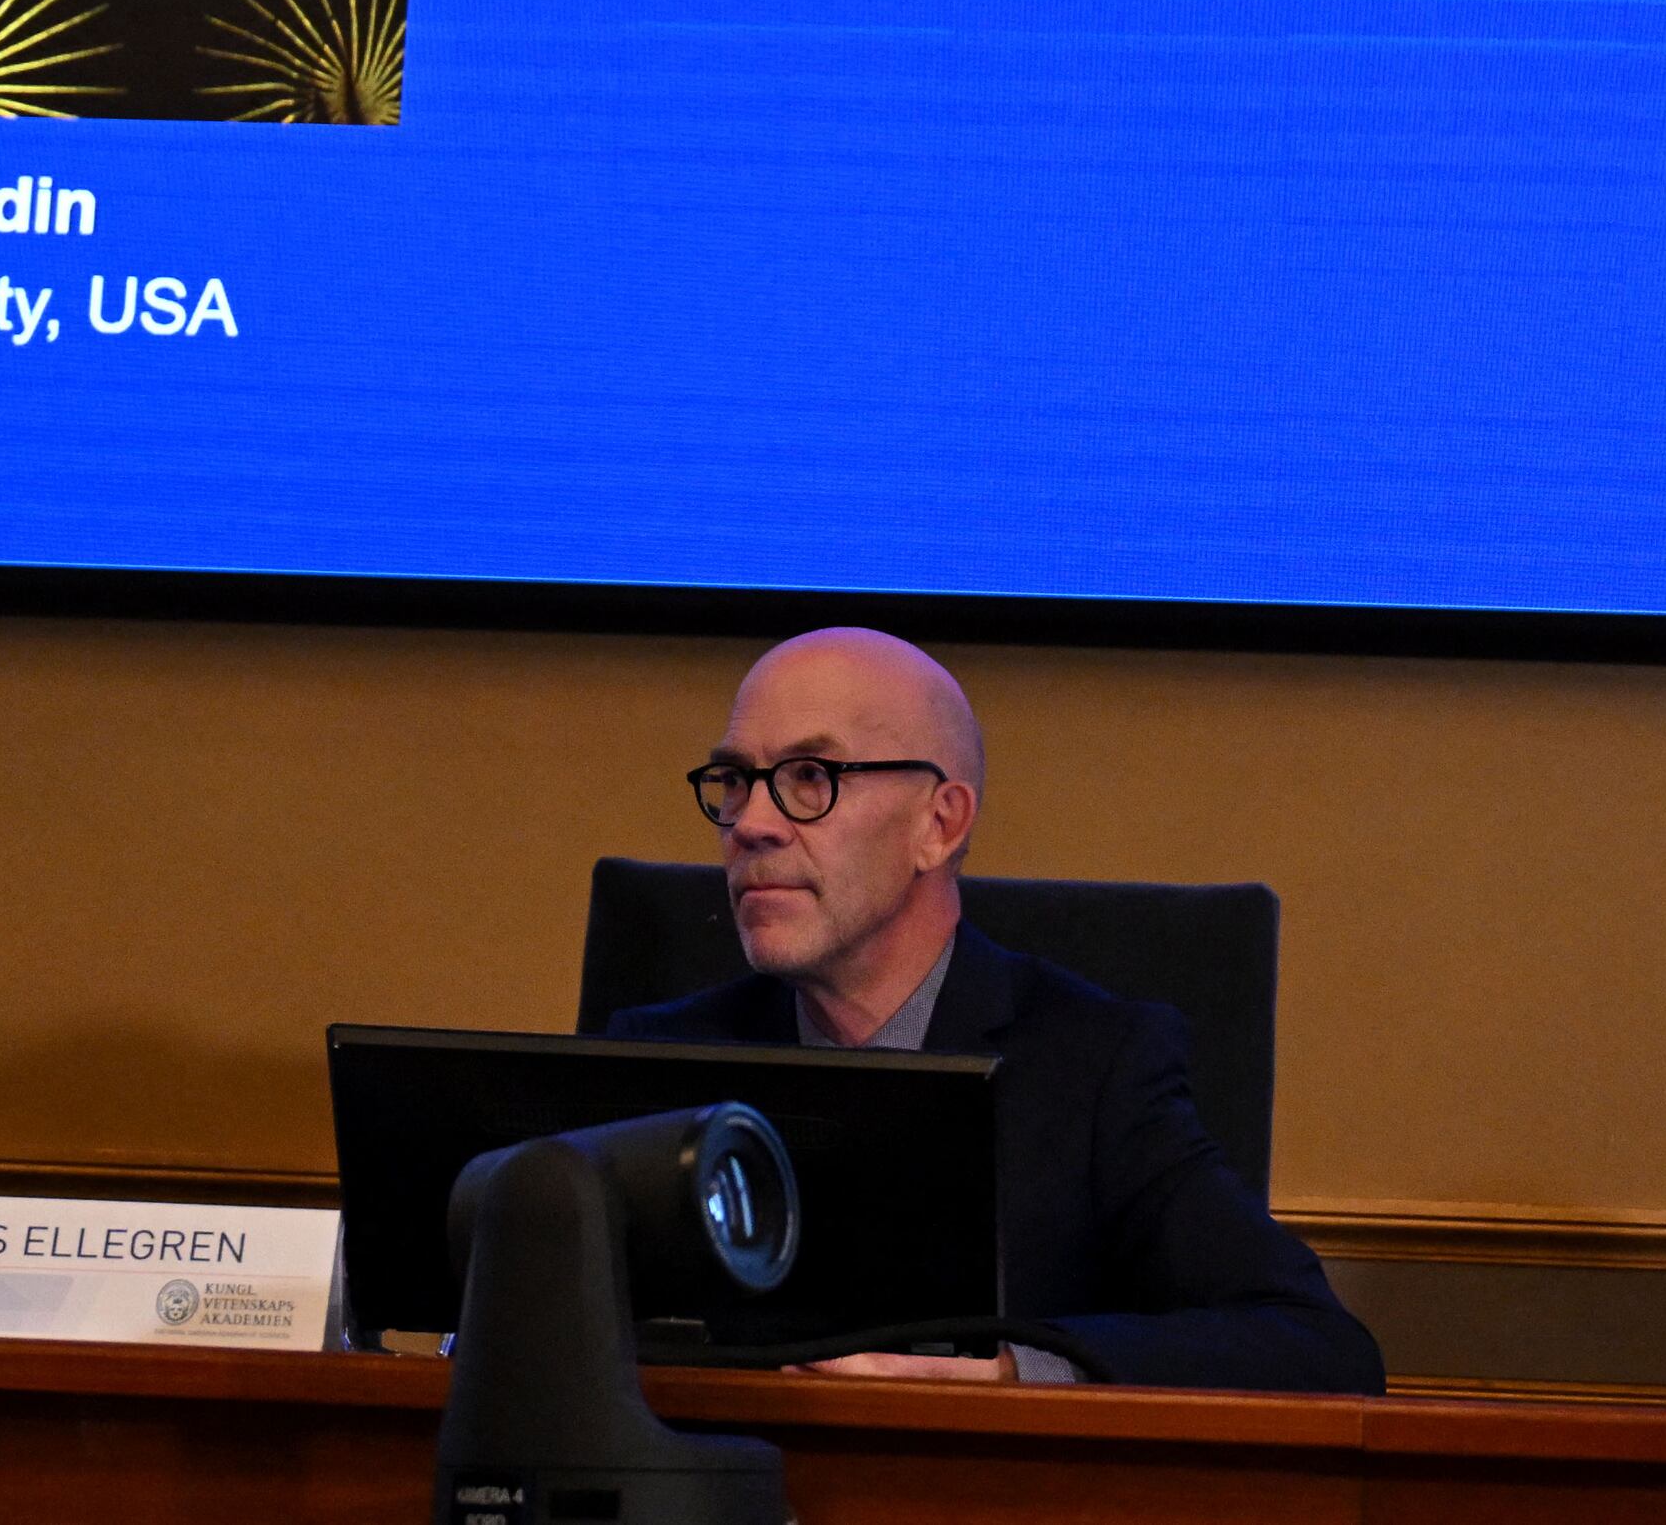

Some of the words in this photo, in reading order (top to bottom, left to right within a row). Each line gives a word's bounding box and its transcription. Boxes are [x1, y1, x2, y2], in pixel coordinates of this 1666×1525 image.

[90, 276, 238, 336] USA
[23, 1225, 247, 1263] ELLEGREN
[201, 1314, 293, 1326] AKADEMIEN
